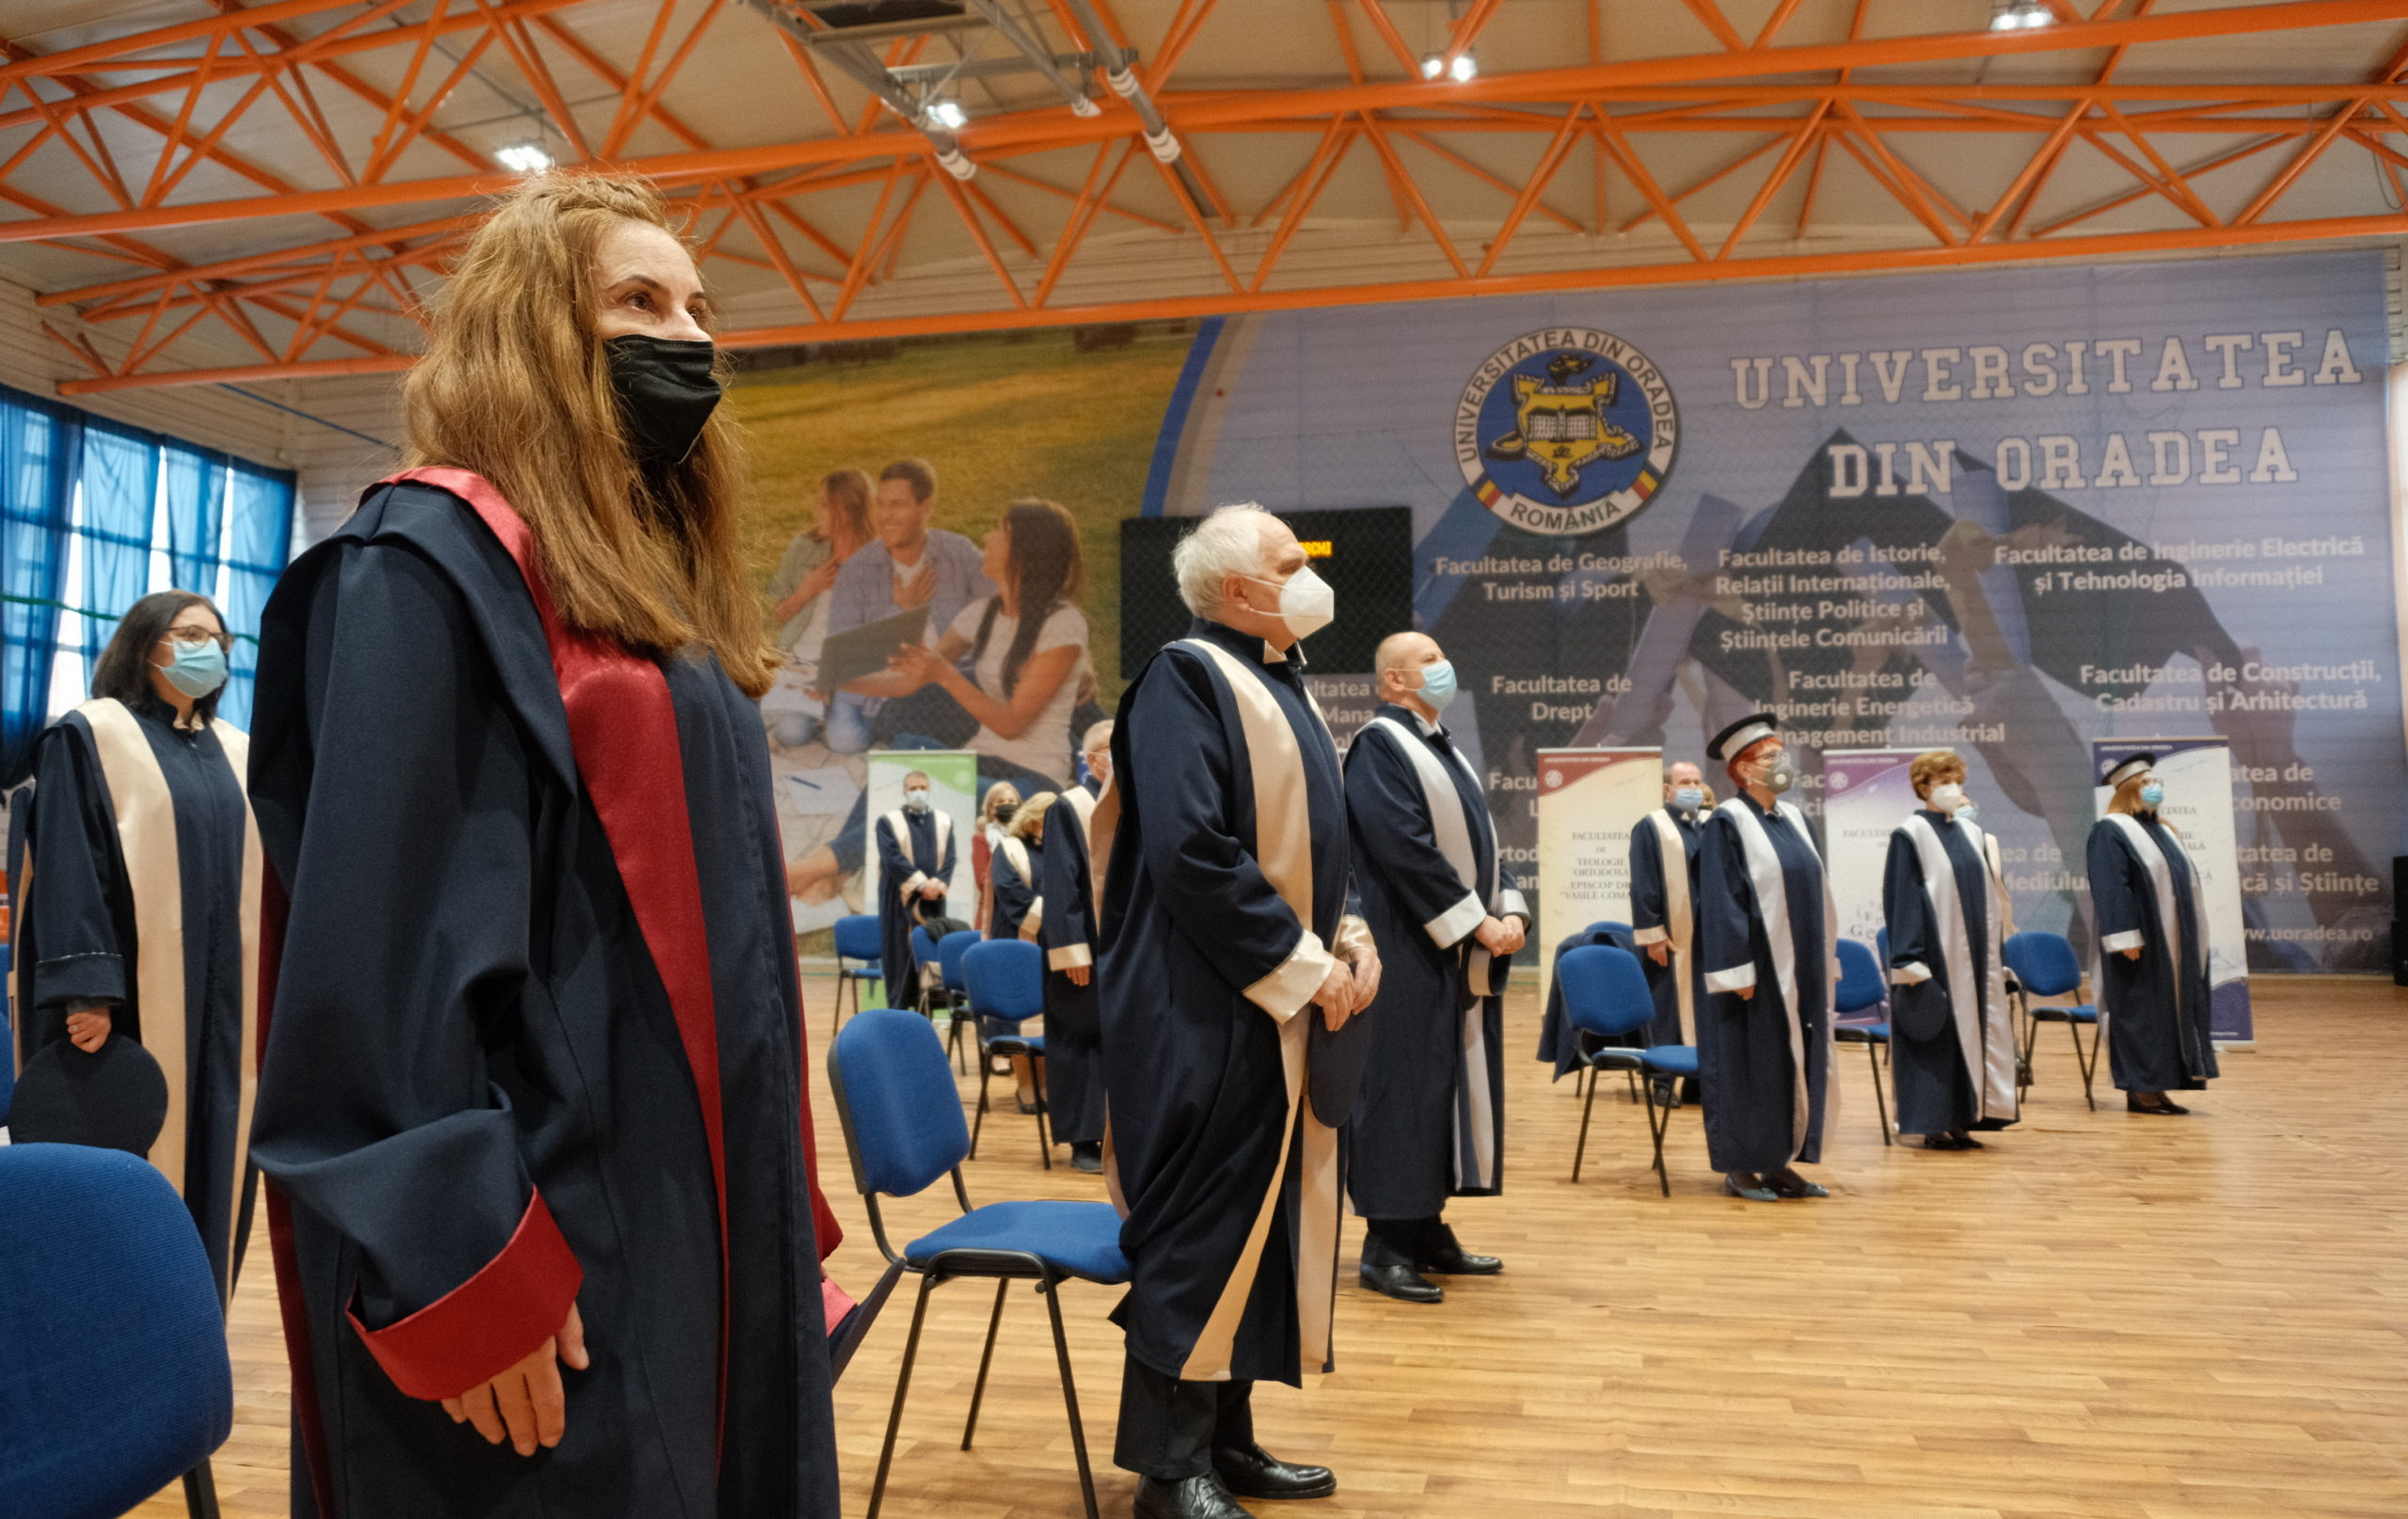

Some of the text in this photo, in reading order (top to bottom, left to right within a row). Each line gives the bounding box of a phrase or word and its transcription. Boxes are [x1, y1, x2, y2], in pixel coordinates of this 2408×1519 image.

[1731, 328, 2363, 410] UNIVERSITATEA
[1457, 330, 1672, 464] UNIVERSITATEA DIN ORADEA
[1829, 426, 2298, 498] DIN ORADEA
[1510, 499, 1622, 531] ROMÂNIA
[1719, 542, 1946, 568] Facultatea de Istorie,
[1994, 535, 2364, 566] Facultatea de Inginerie Electrică
[1435, 551, 1687, 576] Facultatea de Geografie,
[1483, 579, 1640, 603] Turism și Sport
[1716, 570, 1951, 597] Relații Internaționale,
[2035, 566, 2323, 595] și Tehnologia Informației
[1818, 599, 1902, 620] Politice
[1908, 597, 1925, 621] și
[1816, 625, 1948, 647] Comunicării
[1492, 672, 1633, 694] Facultatea de
[1789, 668, 1937, 690] Facultatea de
[2081, 659, 2381, 686] Facultatea de Construcții,
[1313, 680, 1370, 698] ltatea
[1531, 702, 1593, 723] Drept
[1755, 695, 1974, 720] Inginerie Energetică
[2096, 688, 2368, 715] Cadastru și Arhitectură
[1323, 705, 1375, 723] Mana
[1898, 722, 2005, 744] Industrial
[1489, 772, 1538, 791] Facu
[2230, 762, 2314, 783] atea de
[2232, 791, 2342, 812] conomice
[2034, 842, 2063, 862] de
[2237, 842, 2334, 862] tatea de
